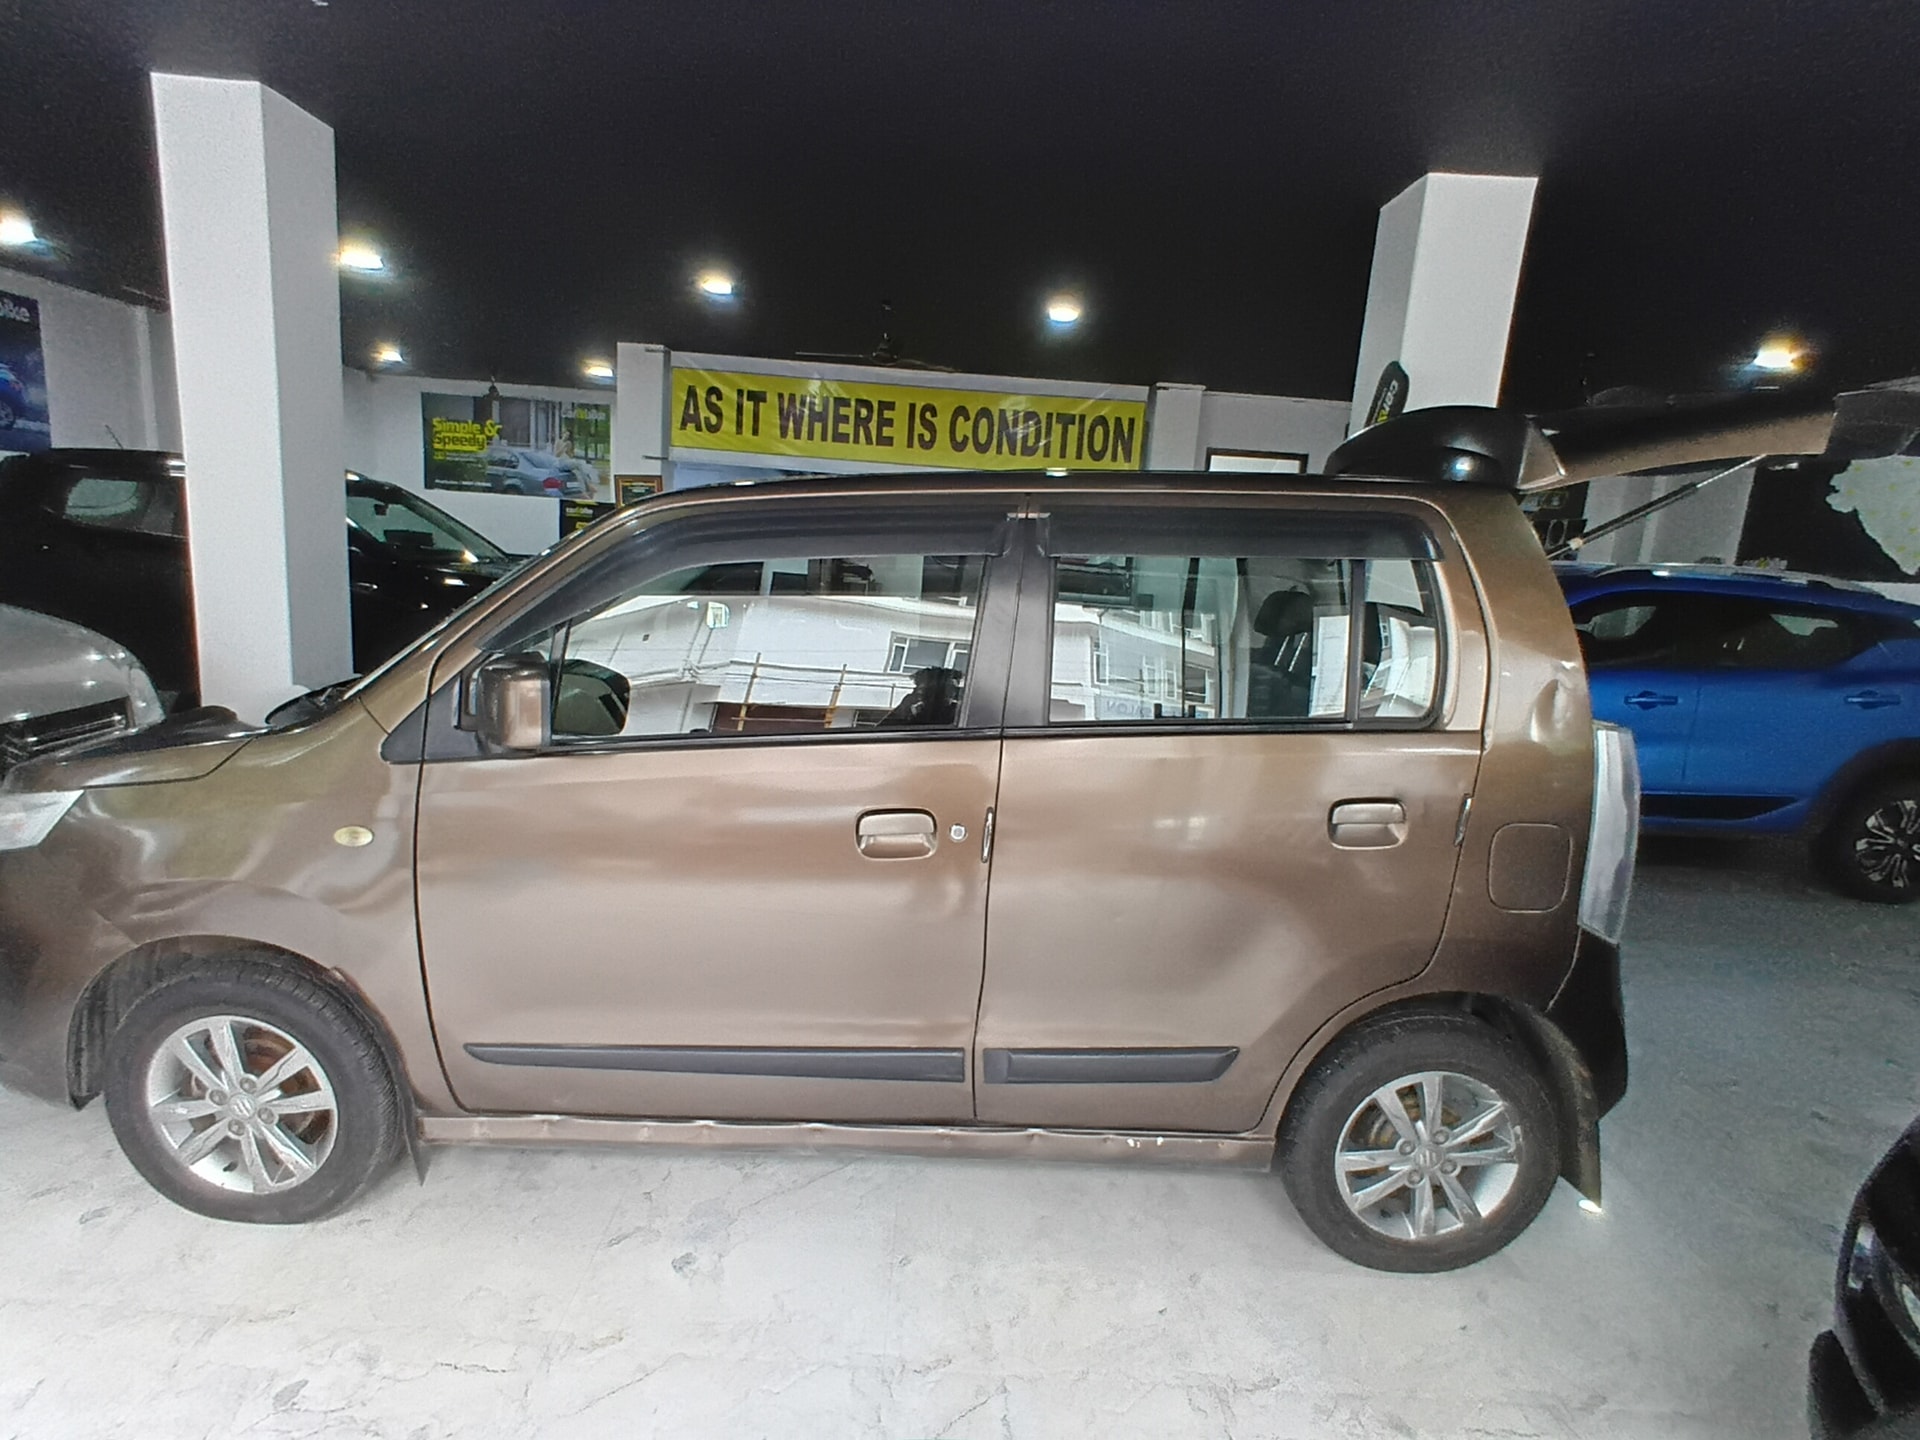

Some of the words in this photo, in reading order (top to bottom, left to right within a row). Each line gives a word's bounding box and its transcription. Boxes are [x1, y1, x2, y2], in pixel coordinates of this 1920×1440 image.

[432, 417, 481, 434] Simple
[484, 419, 503, 436] &
[680, 385, 723, 433] AS
[735, 388, 767, 436] IT
[777, 391, 896, 447] WHERE
[906, 402, 938, 450] IS
[949, 405, 1136, 463] CONDITION
[433, 434, 485, 450] Speedy
